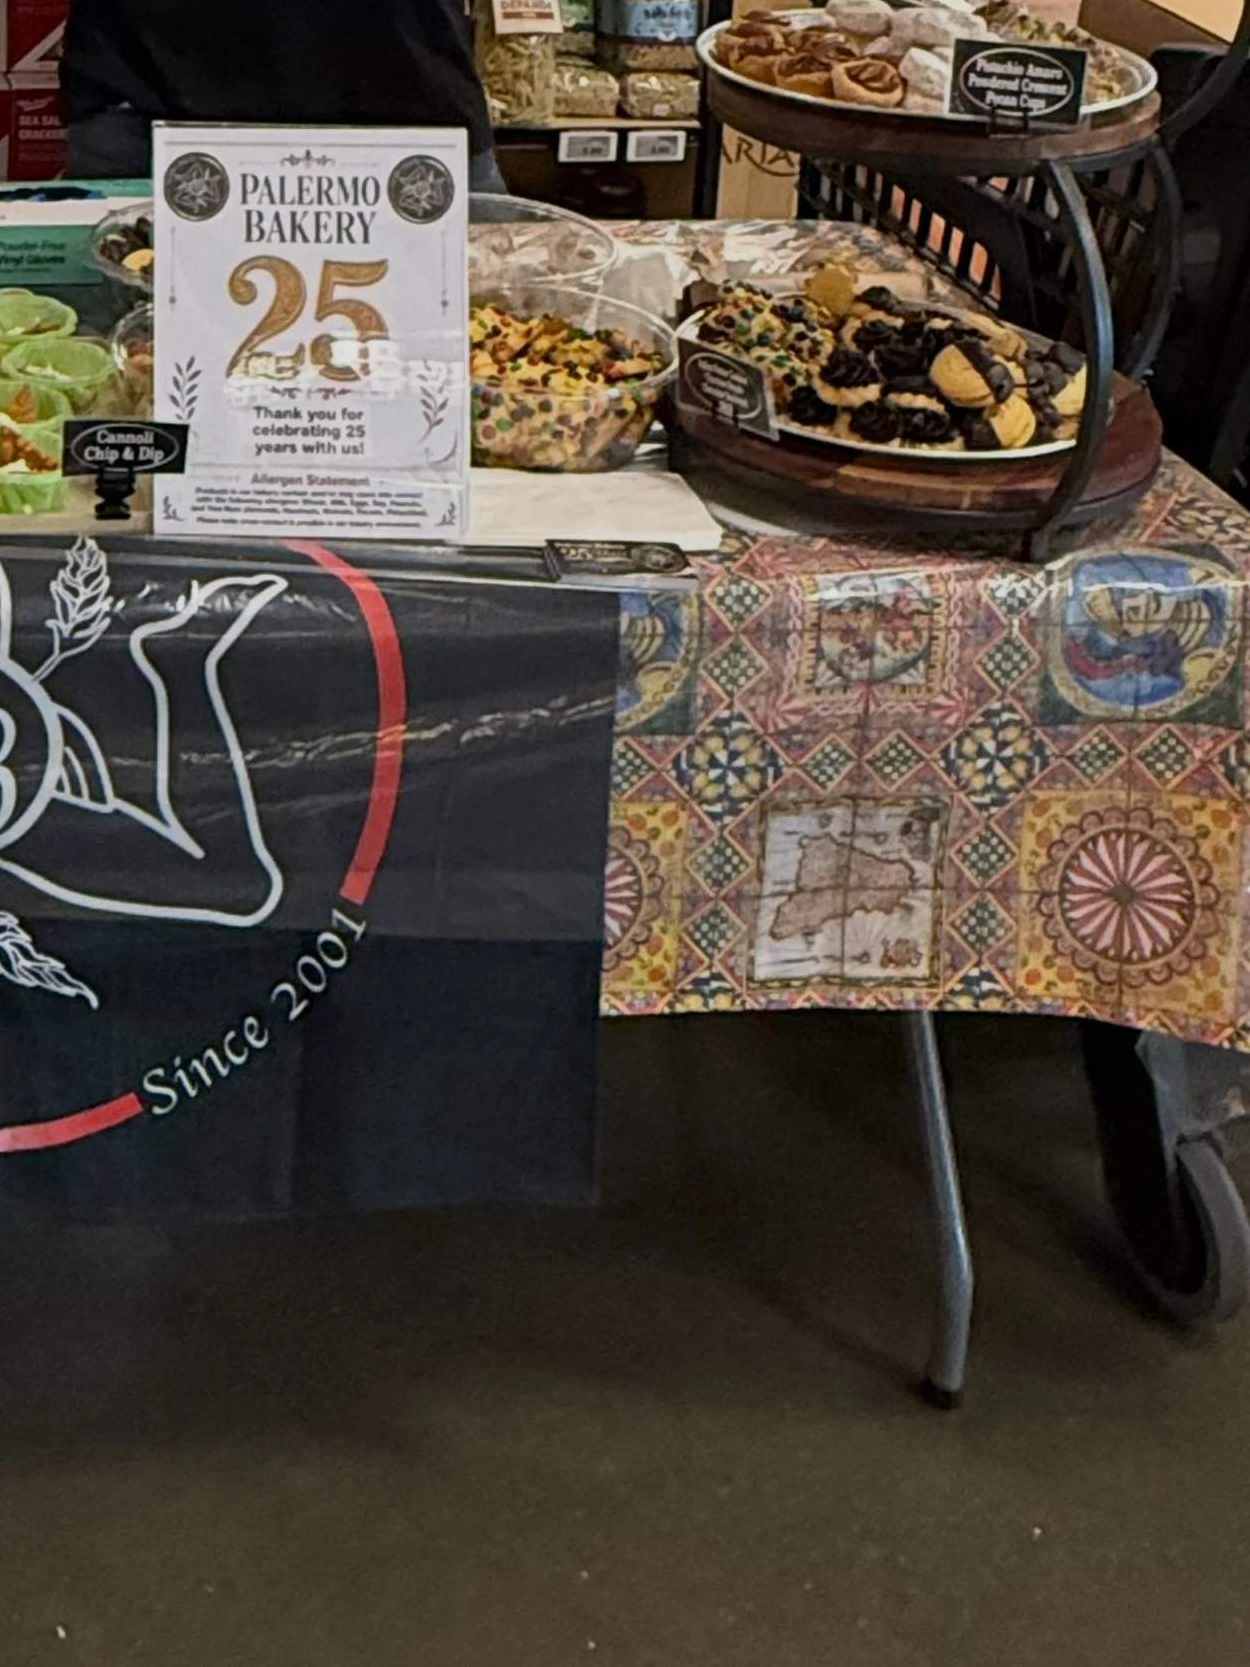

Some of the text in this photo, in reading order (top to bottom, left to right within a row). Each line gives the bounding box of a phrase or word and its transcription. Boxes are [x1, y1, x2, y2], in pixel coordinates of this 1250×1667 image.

[239, 172, 381, 207] PALERMO
[243, 209, 377, 244] BAKERY
[225, 254, 390, 384] 25
[252, 405, 364, 423] Thank you for
[96, 428, 155, 445] Cannoli
[251, 423, 366, 441] celebrating 25
[83, 445, 119, 465] Chip
[138, 445, 165, 464] Dip
[254, 440, 365, 456] years with us!
[250, 472, 370, 487] Allergen Statement
[141, 907, 368, 1116] Since 2001
